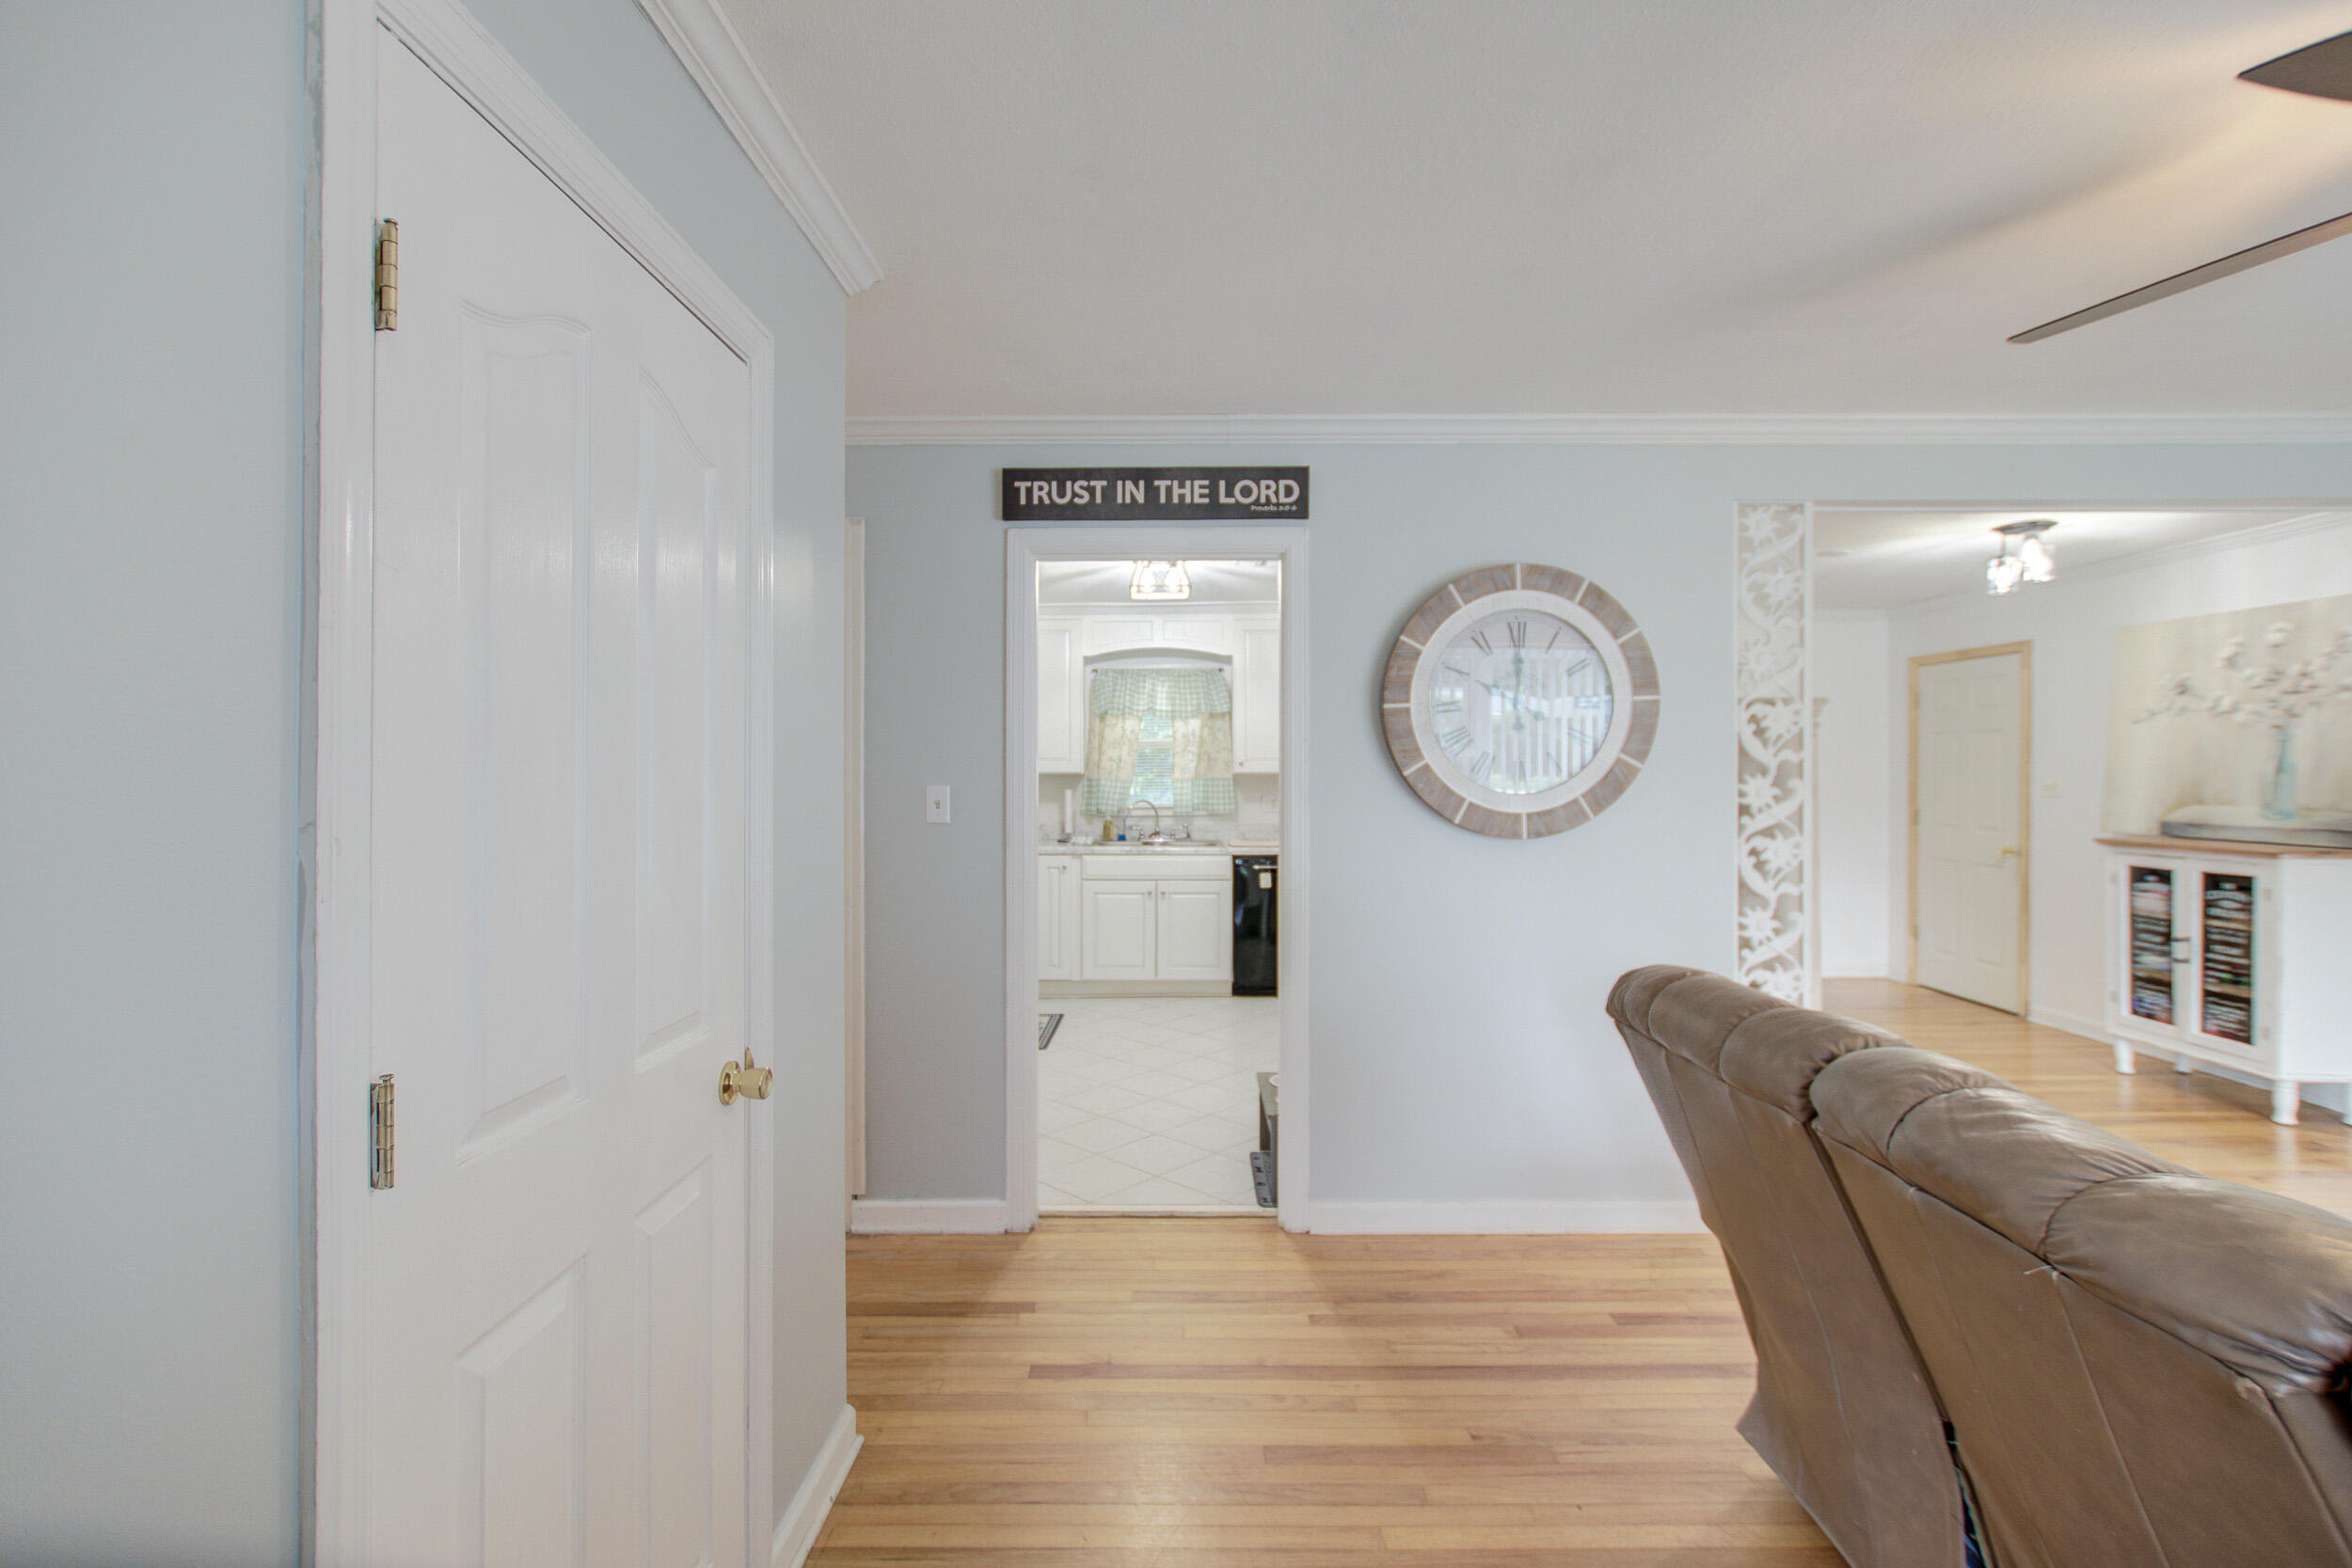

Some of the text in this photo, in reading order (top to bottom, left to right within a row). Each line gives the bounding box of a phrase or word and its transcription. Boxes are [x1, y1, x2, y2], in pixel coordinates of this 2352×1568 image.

[1014, 479, 1300, 505] TRUST IN THE LORD
